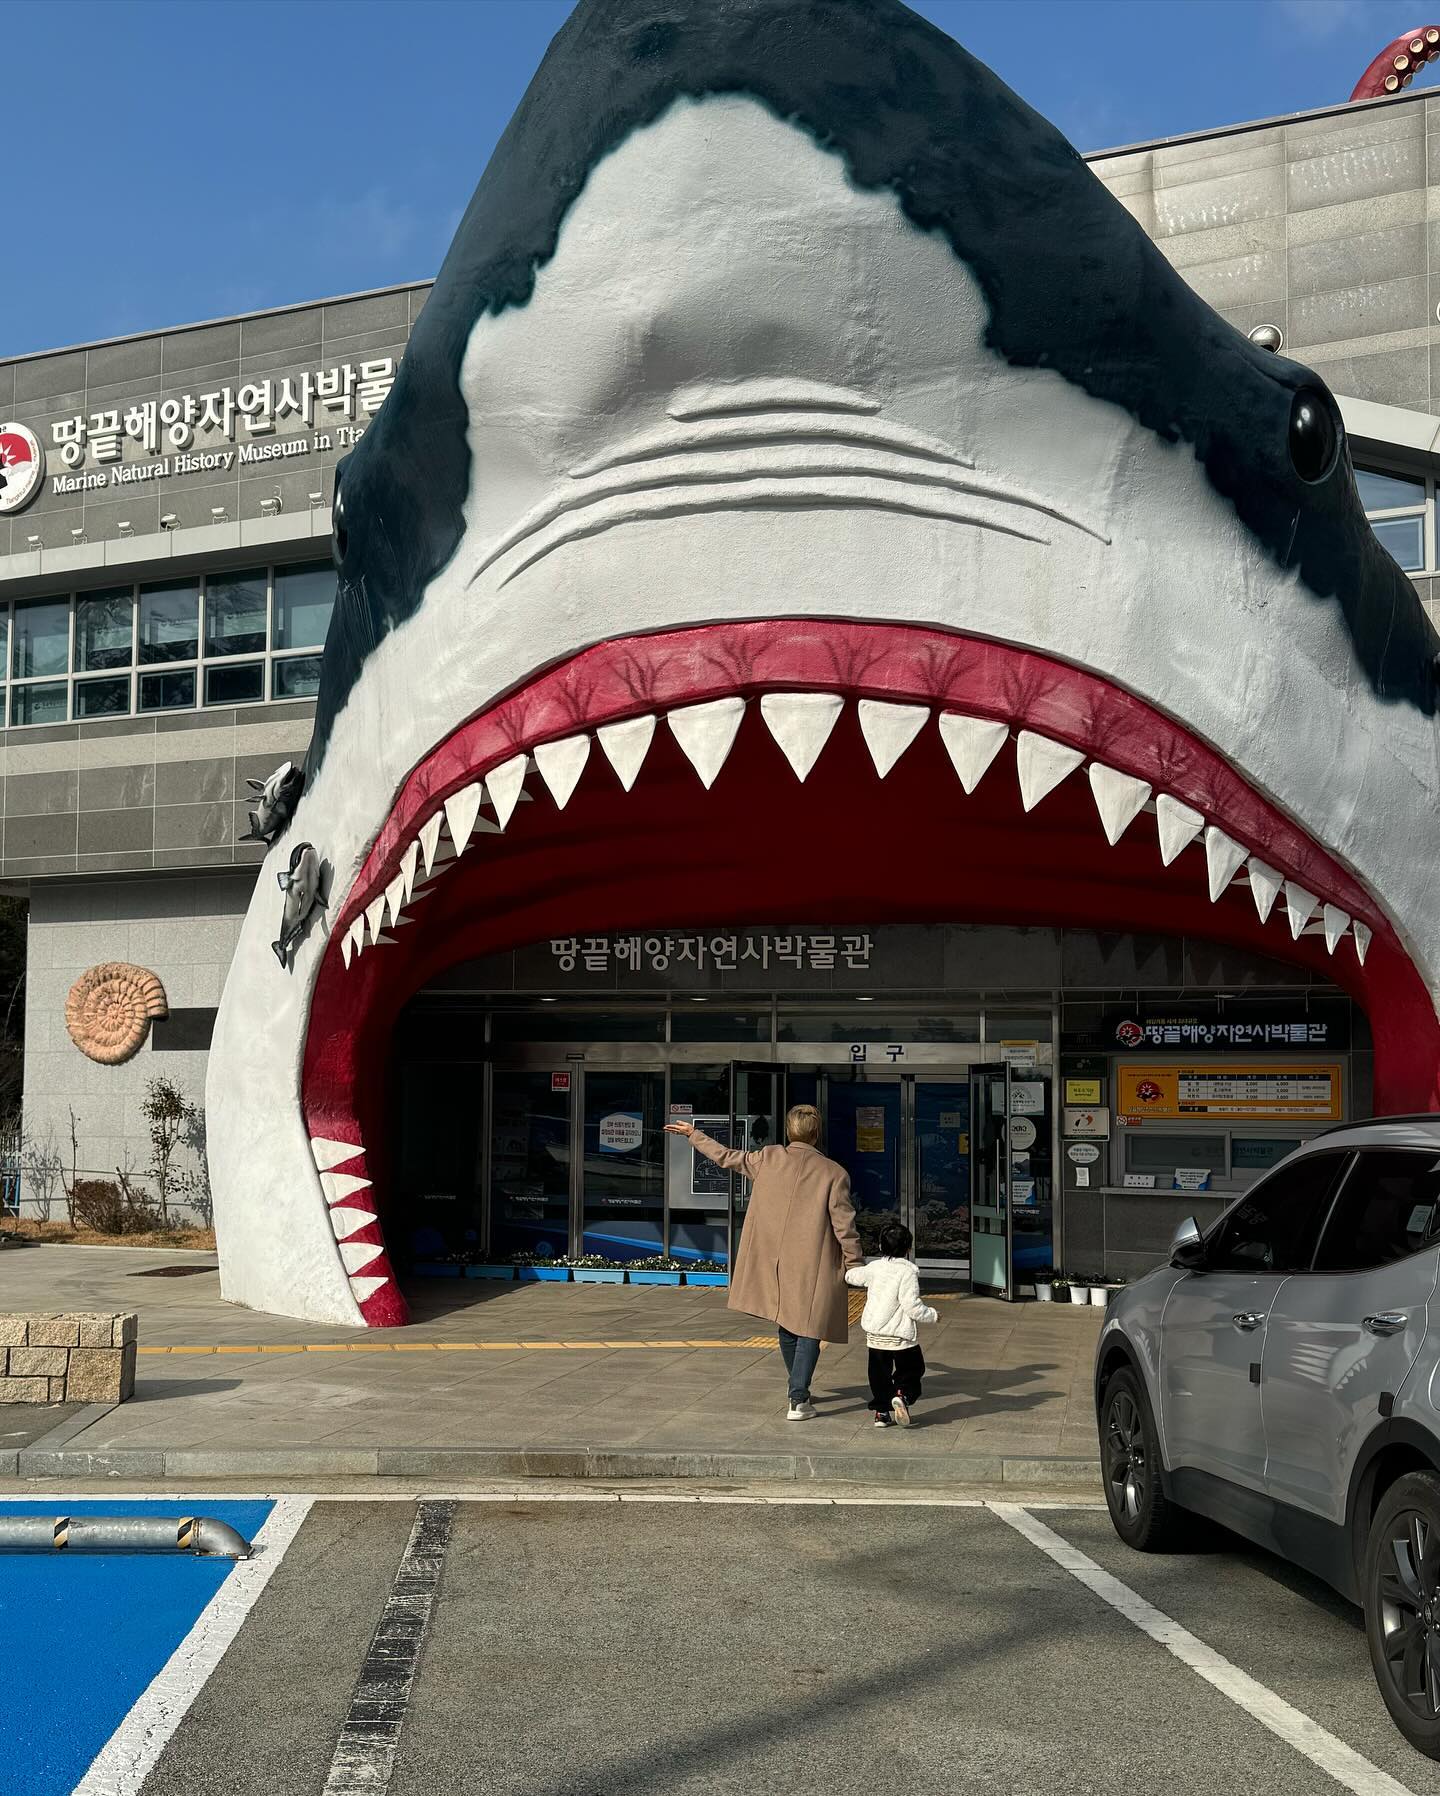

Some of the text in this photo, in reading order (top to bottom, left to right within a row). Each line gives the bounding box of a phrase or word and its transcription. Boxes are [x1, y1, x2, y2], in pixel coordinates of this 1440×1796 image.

[53, 471, 107, 494] Marine
[112, 458, 169, 484] Natural
[174, 451, 233, 474] History
[238, 440, 308, 463] Museum
[314, 431, 331, 450] in
[550, 935, 874, 972] 땅끝해양자연사박물관
